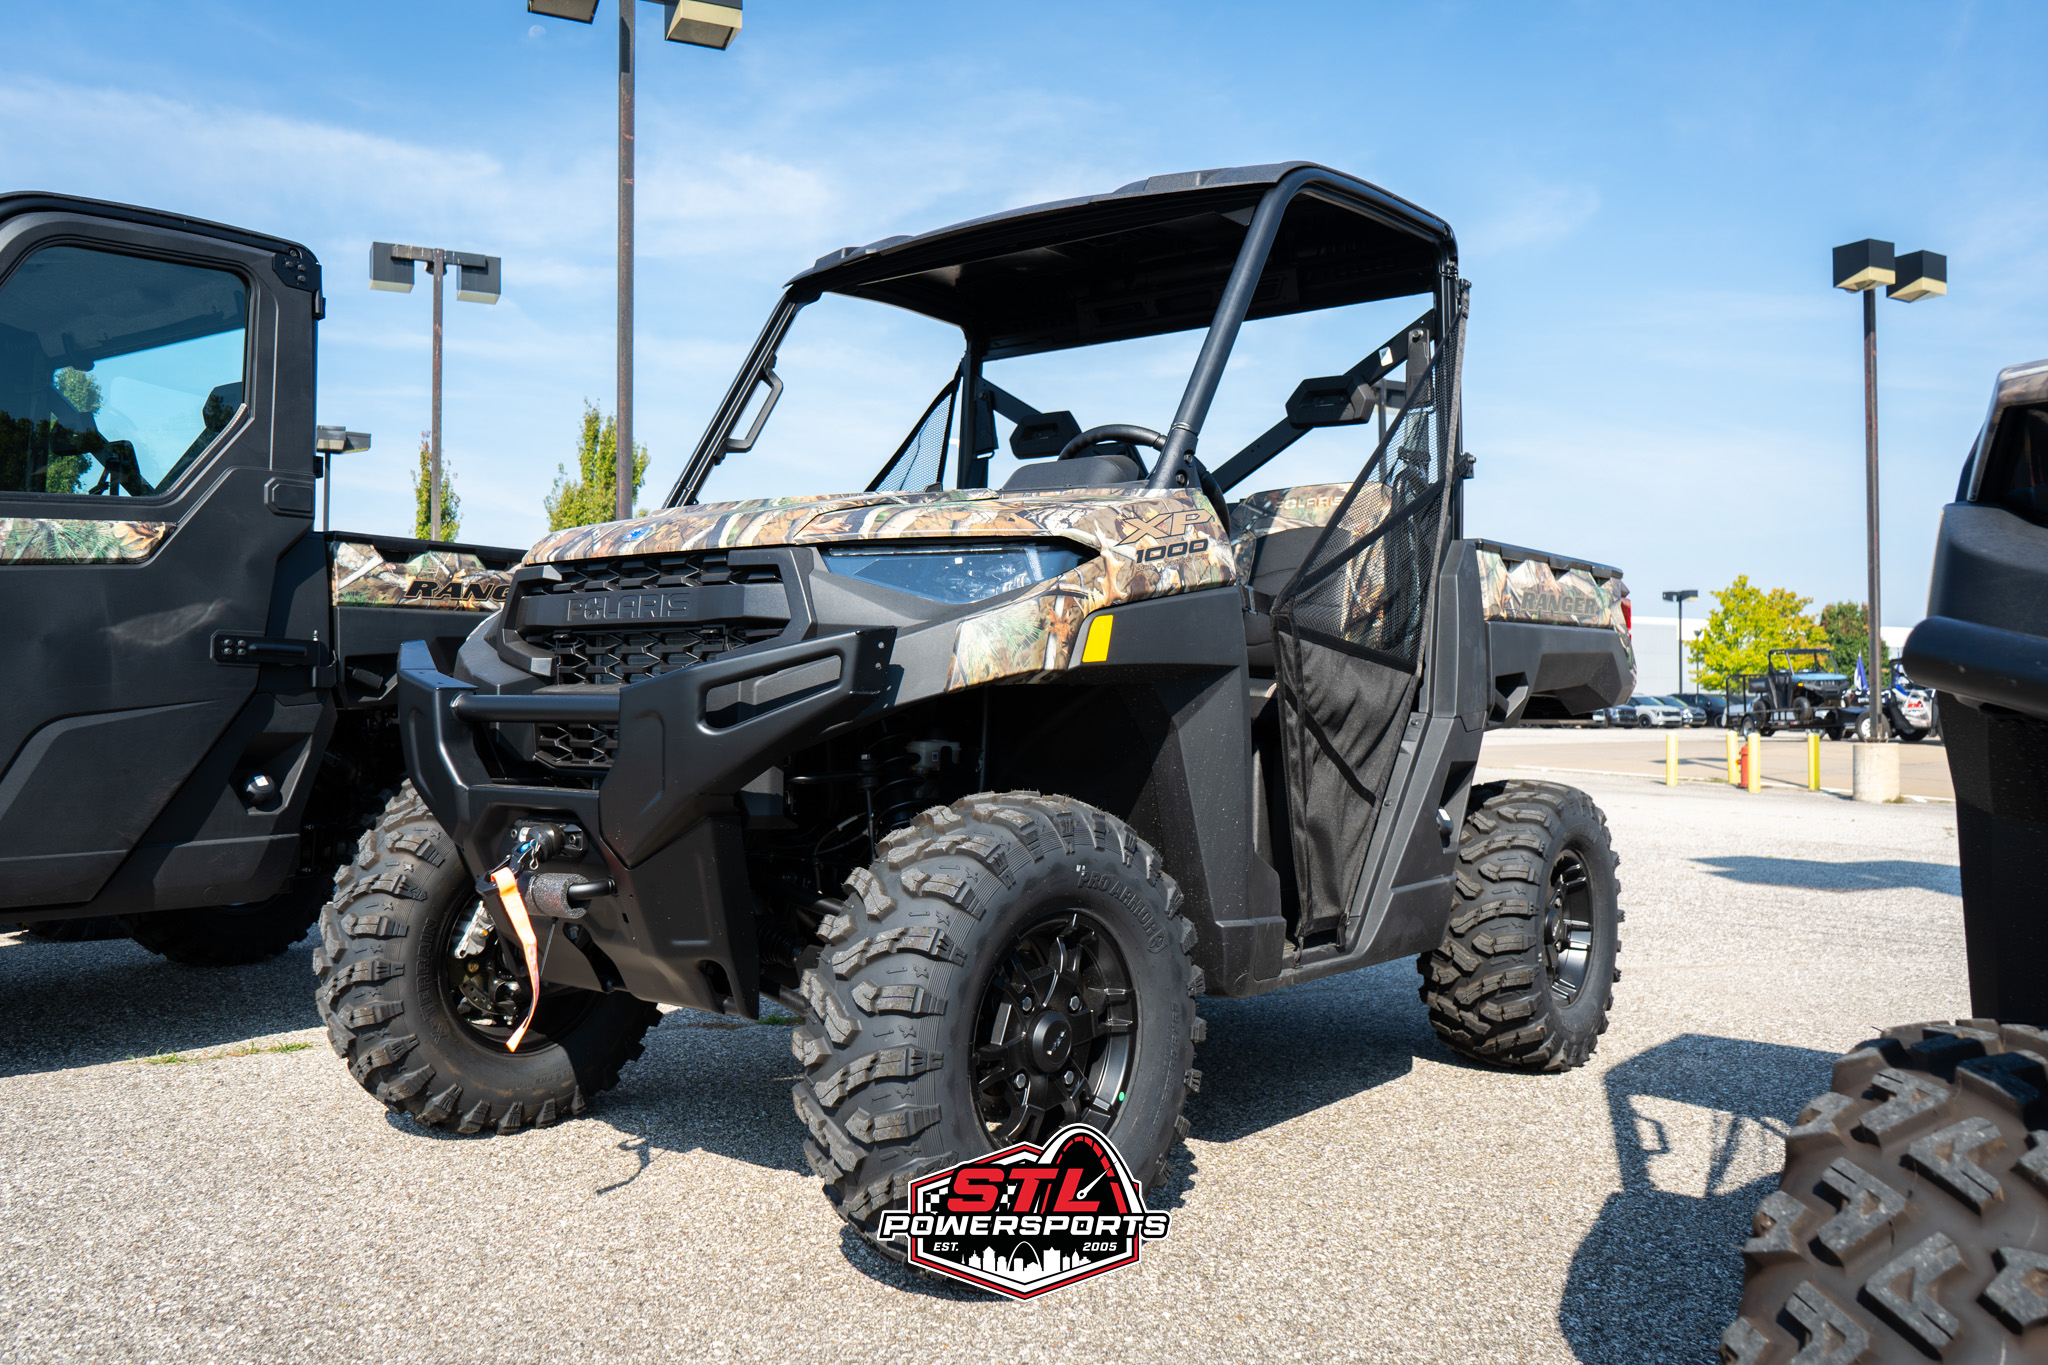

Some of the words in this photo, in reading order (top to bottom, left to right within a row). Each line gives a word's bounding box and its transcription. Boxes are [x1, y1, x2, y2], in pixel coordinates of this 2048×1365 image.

[1114, 508, 1213, 548] XP
[1136, 538, 1209, 564] 1000
[404, 580, 510, 603] RANG
[1520, 591, 1598, 616] RANGER
[566, 592, 690, 621] POLARIS
[1078, 870, 1112, 892] PRO
[1108, 880, 1158, 937] ARMOR
